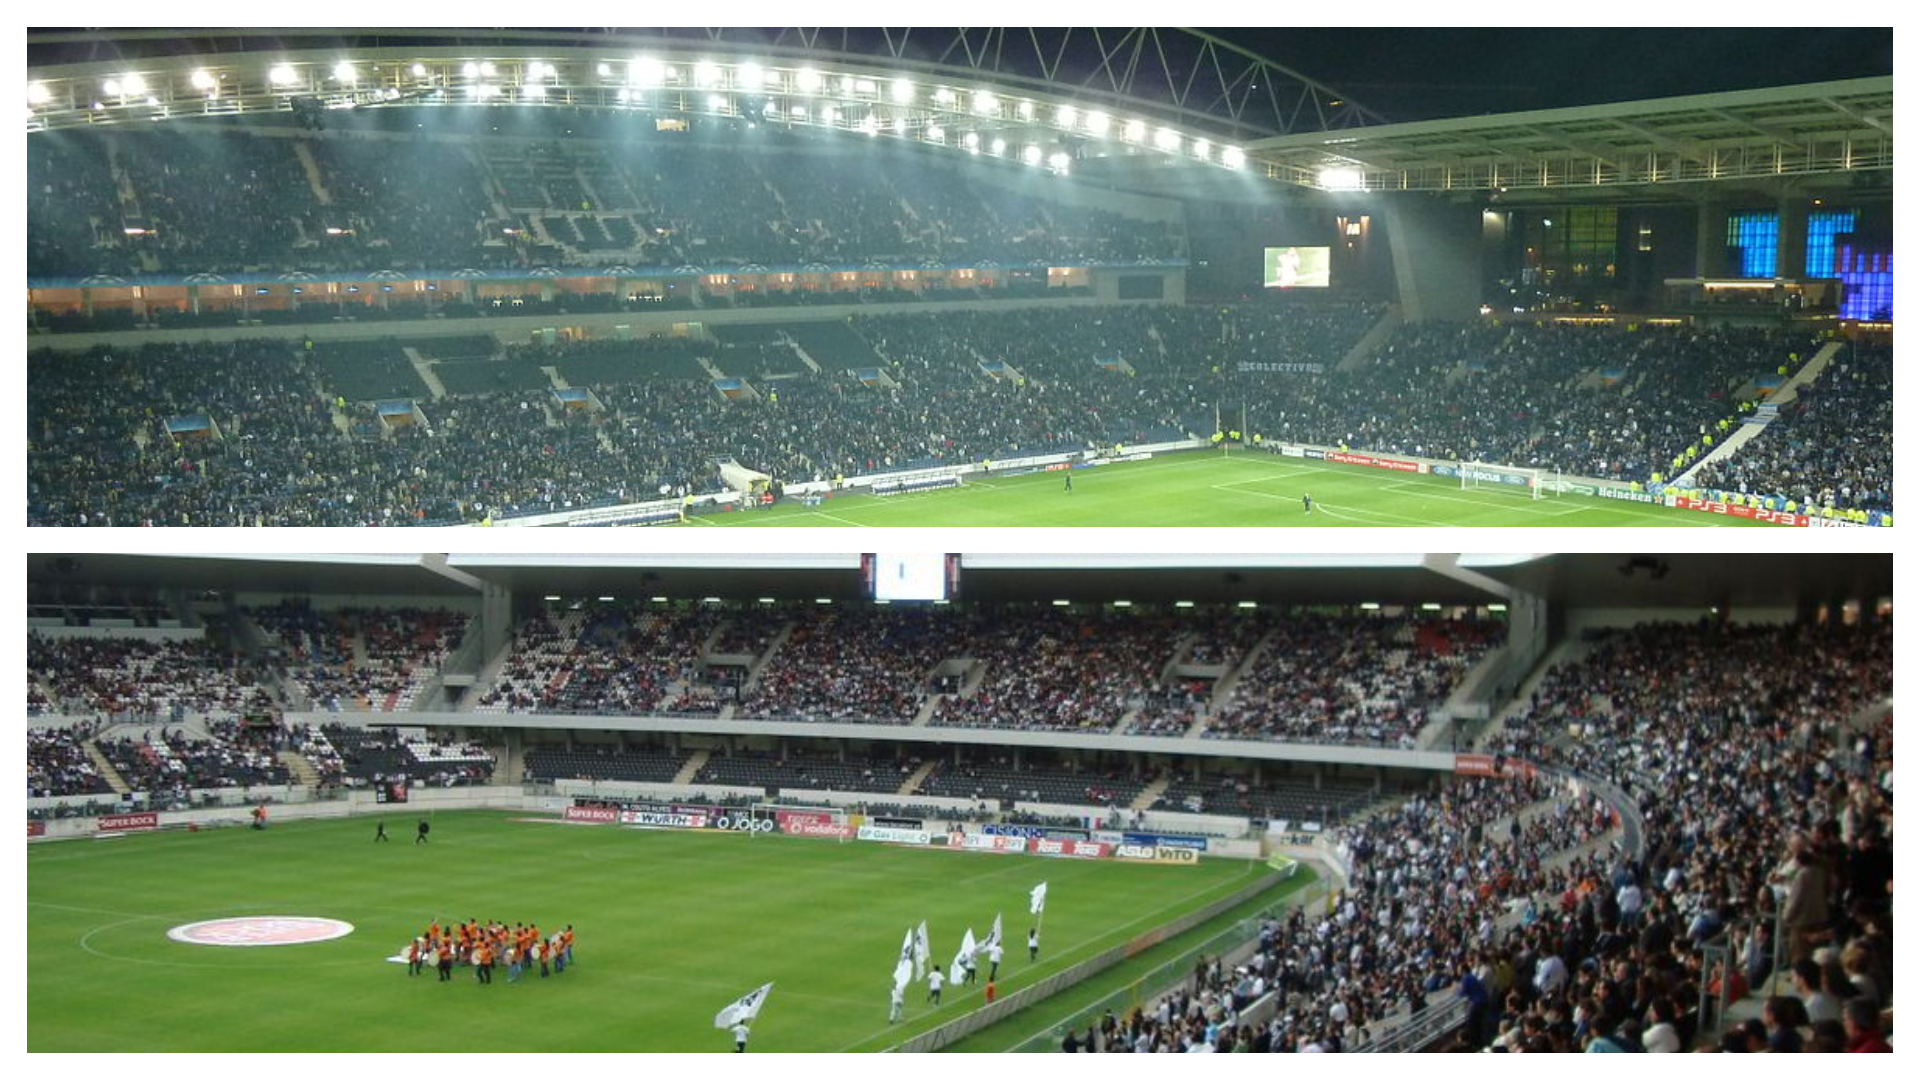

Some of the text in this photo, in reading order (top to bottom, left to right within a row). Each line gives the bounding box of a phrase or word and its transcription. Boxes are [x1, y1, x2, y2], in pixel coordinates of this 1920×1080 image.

[1599, 486, 1652, 503] Heineken
[1689, 498, 1728, 514] PS3
[1756, 508, 1796, 525] PS3
[101, 815, 156, 828] SUPER BOCK
[568, 808, 615, 820] SUPER BOCK
[717, 817, 729, 829] O
[731, 817, 774, 832] JOGO
